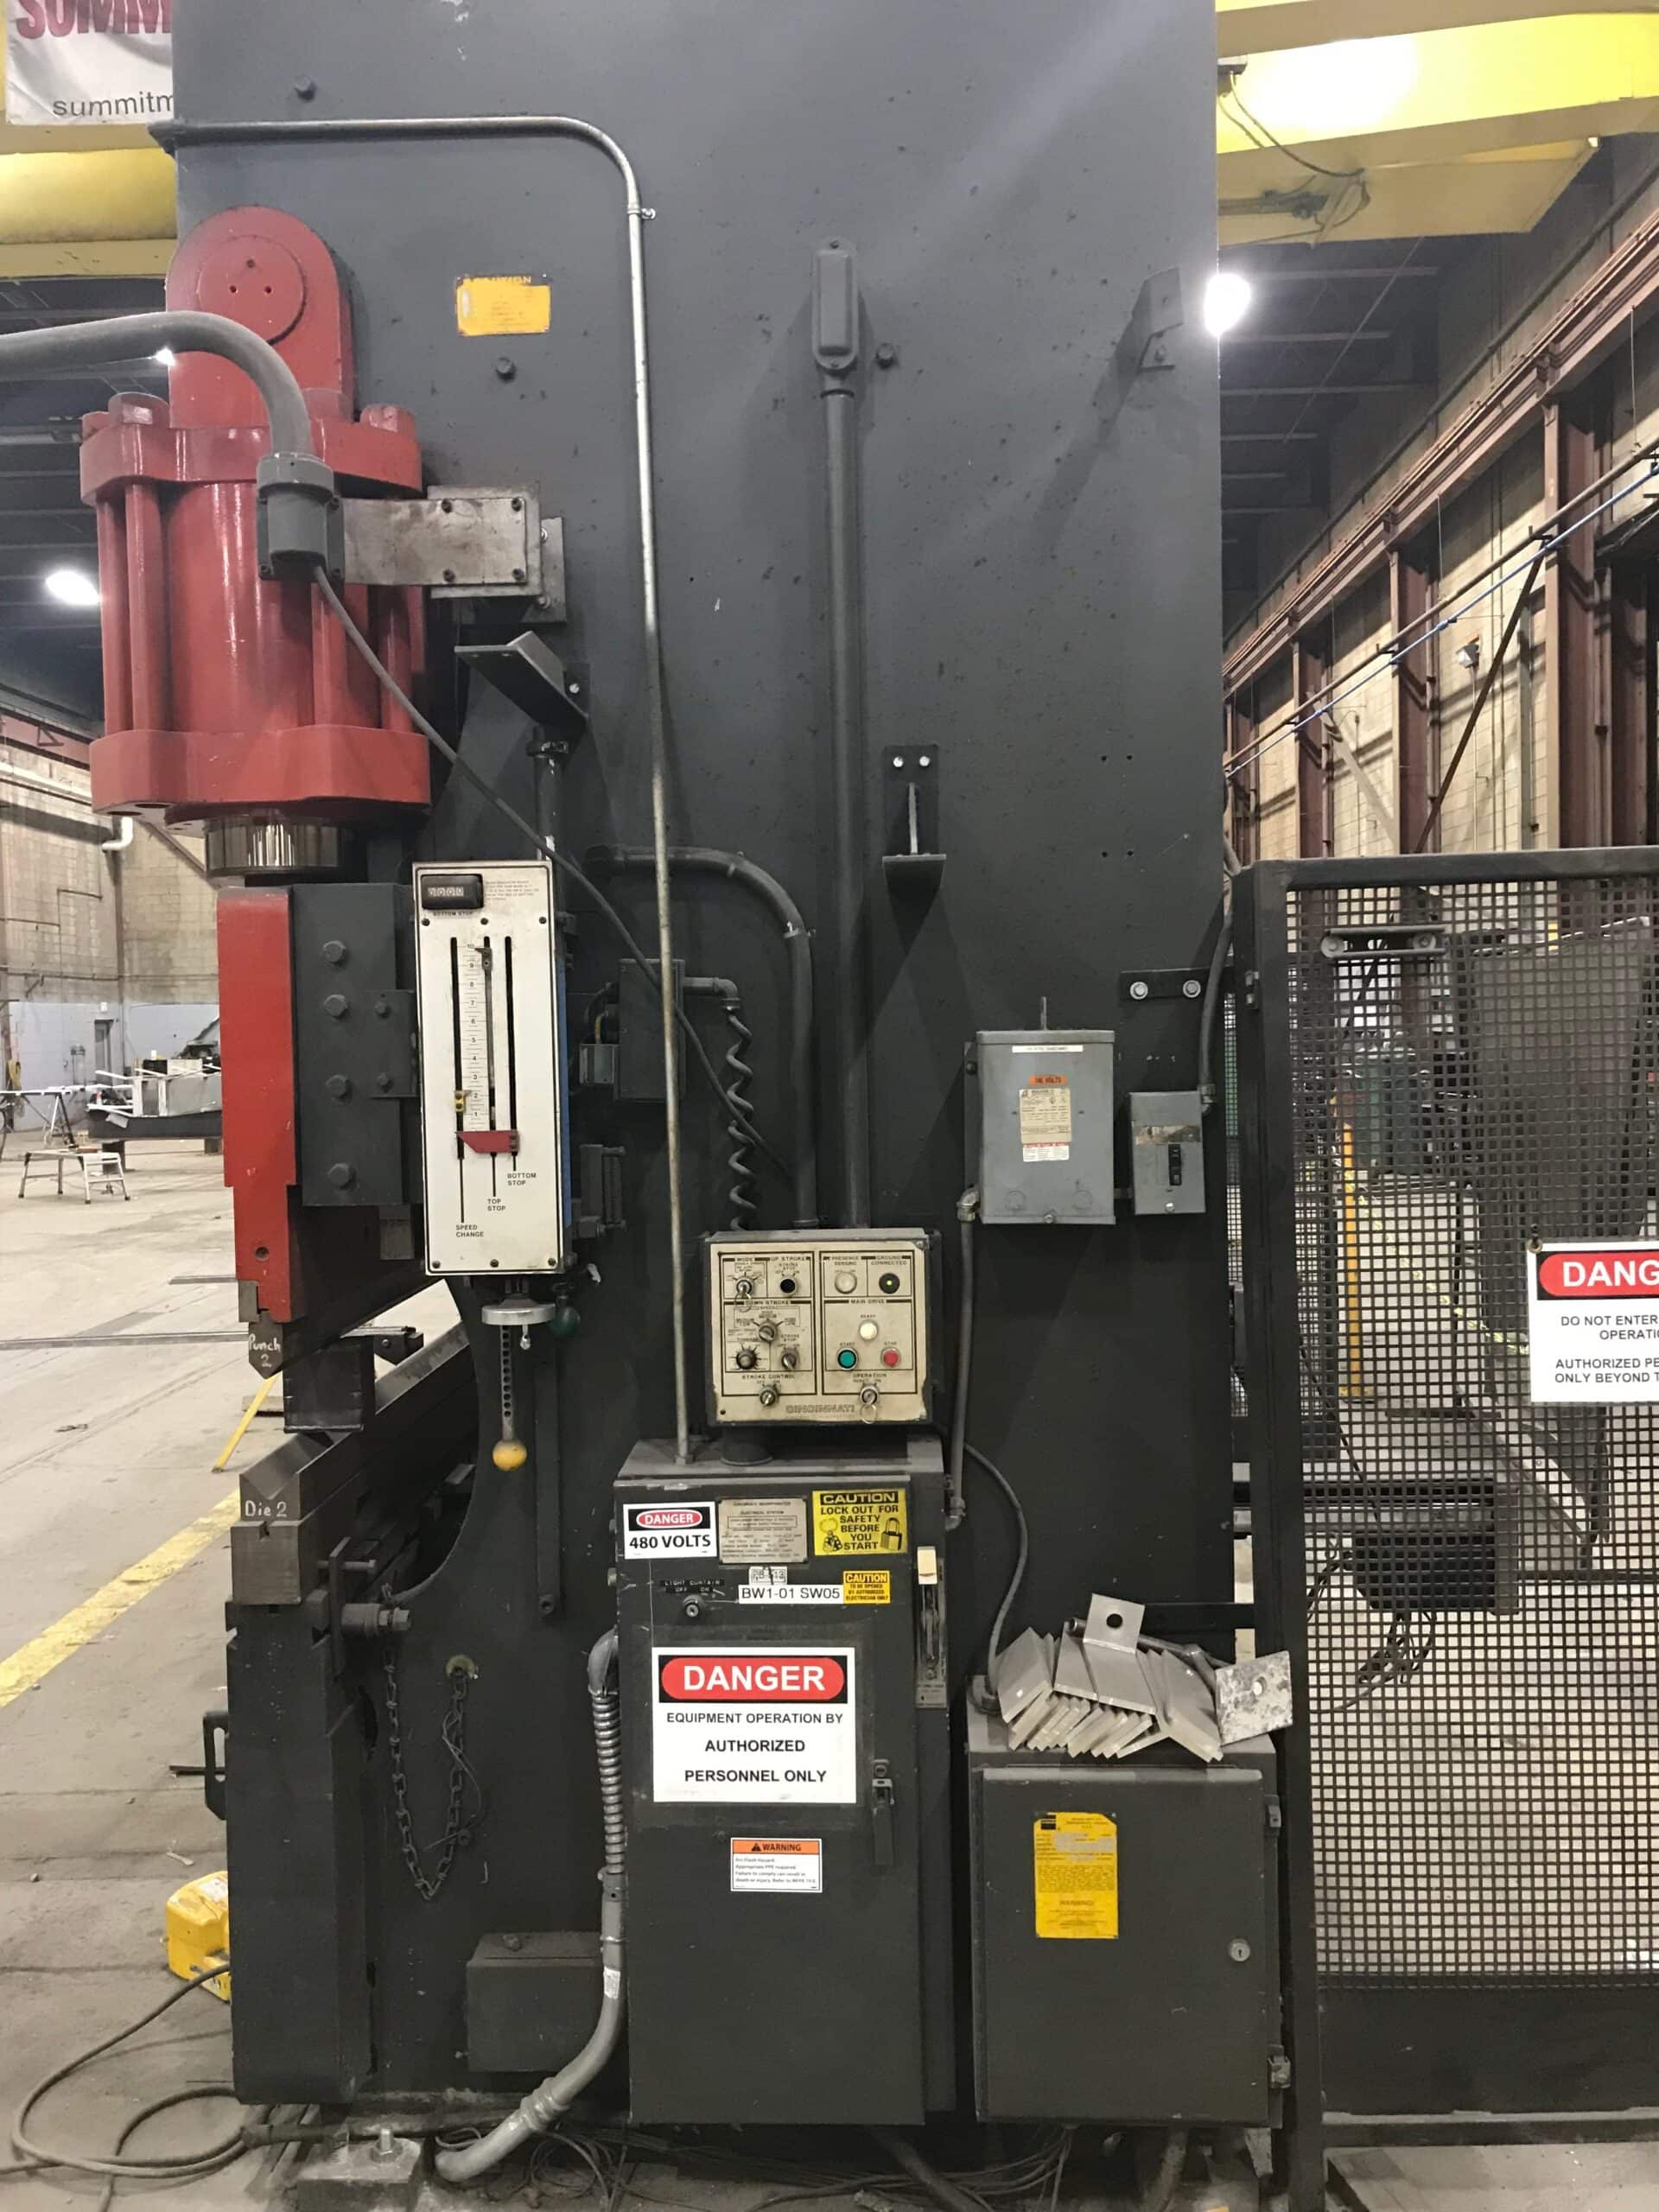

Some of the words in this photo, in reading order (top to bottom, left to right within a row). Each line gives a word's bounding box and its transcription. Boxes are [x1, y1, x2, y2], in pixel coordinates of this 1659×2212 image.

[1562, 1260, 1659, 1287] DANG
[1561, 1316, 1580, 1326] DO
[1585, 1315, 1611, 1325] NOT
[1616, 1315, 1658, 1325] ENTER
[1599, 1329, 1659, 1340] OPERATI
[248, 1334, 281, 1352] Punch
[260, 1354, 272, 1368] 2
[1555, 1357, 1641, 1369] AUTHORIZED
[1555, 1373, 1591, 1383] ONLY
[1595, 1372, 1650, 1382] BEYOND
[785, 1404, 855, 1414] CINCINNATI
[823, 1493, 895, 1503] CAUTION
[245, 1500, 271, 1517] Die
[276, 1501, 288, 1517] 2
[645, 1513, 694, 1524] DANGER
[840, 1515, 880, 1523] SAFETY
[841, 1523, 880, 1533] BEFORE
[629, 1536, 658, 1549] 480
[661, 1534, 711, 1548] VOLTS
[850, 1533, 872, 1541] YOU
[843, 1541, 879, 1550] START
[847, 1573, 887, 1583] CAUTION
[741, 1587, 794, 1599] BW1-01
[800, 1587, 840, 1599] SW05
[683, 1665, 825, 1691] DANGER
[666, 1713, 742, 1724] EQUIPMENT
[746, 1713, 822, 1724] OPERATION
[826, 1713, 843, 1724] BY
[705, 1739, 805, 1752] AUTHORIZED
[684, 1770, 779, 1783] PERSONNEL
[784, 1770, 827, 1783] ONLY
[762, 1843, 802, 1852] WARNING
